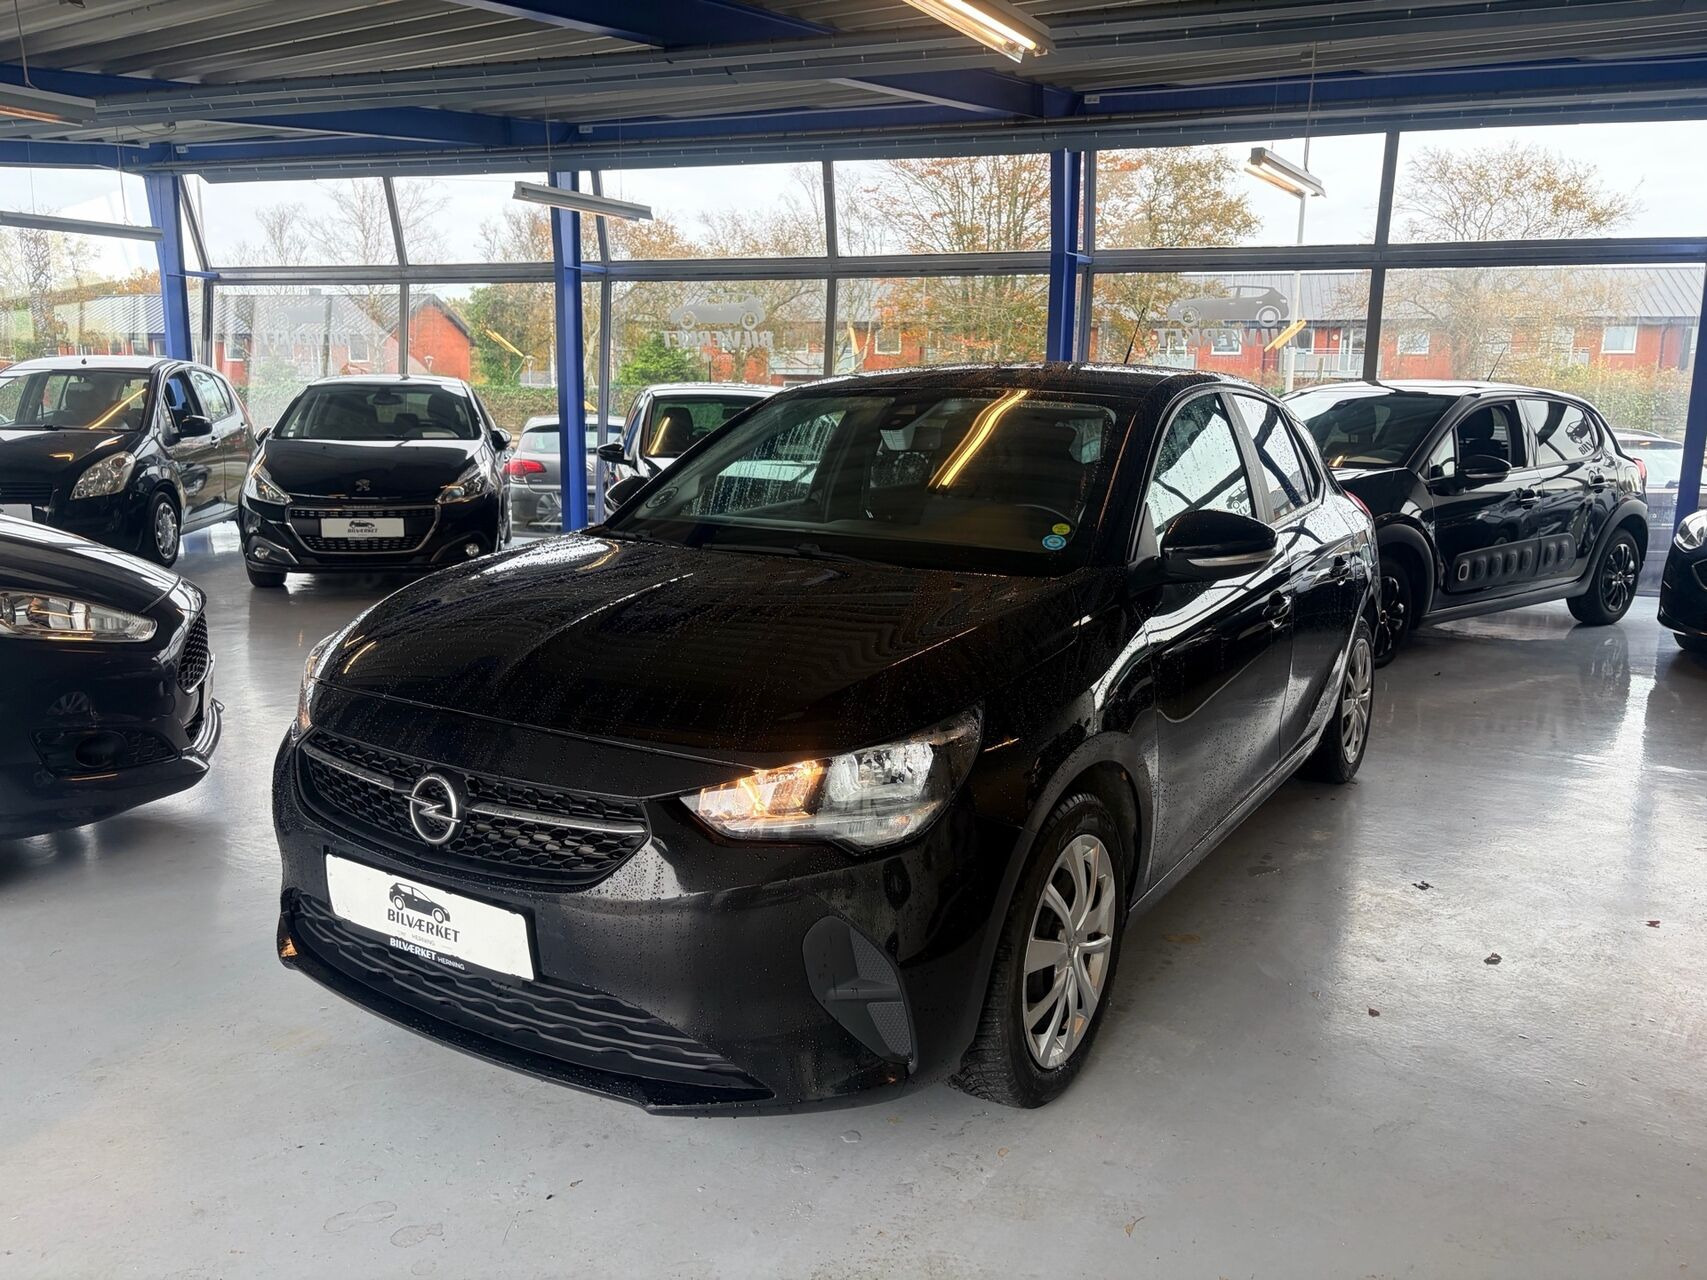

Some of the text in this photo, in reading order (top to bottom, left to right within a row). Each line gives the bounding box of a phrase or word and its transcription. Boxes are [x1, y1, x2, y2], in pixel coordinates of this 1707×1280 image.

[387, 908, 460, 942] BILVÆRKET
[389, 937, 465, 971] BILVÆRKET HERNING
